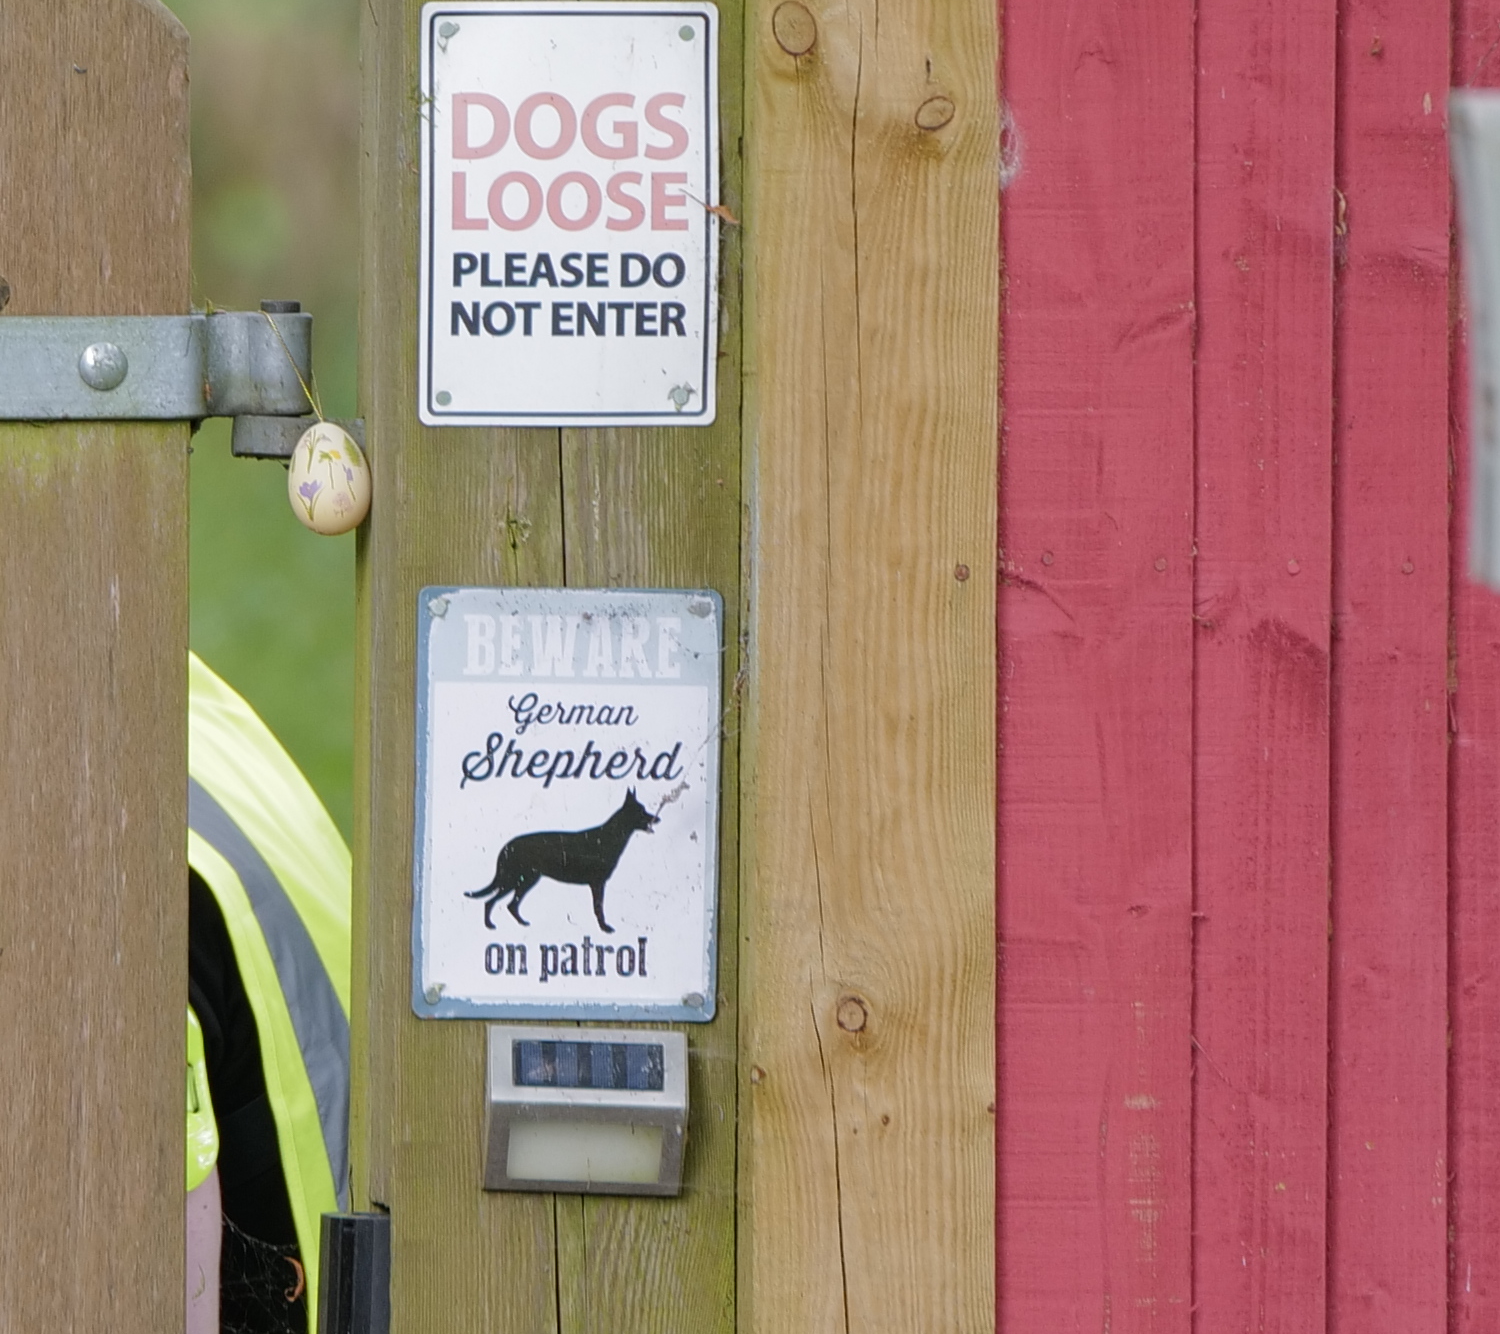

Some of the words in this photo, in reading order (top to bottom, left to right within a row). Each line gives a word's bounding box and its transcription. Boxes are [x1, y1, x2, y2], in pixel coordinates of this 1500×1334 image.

[450, 93, 690, 161] DOGS
[450, 171, 690, 232] LOOSE
[452, 251, 610, 289] PLEASE
[620, 251, 687, 289] DO
[450, 301, 543, 337] NOT
[550, 301, 688, 338] ENTER
[461, 612, 682, 679] BEWARE
[508, 692, 639, 735] German
[459, 731, 684, 790] Shepherd
[484, 942, 528, 976] on
[539, 935, 648, 984] patrol
